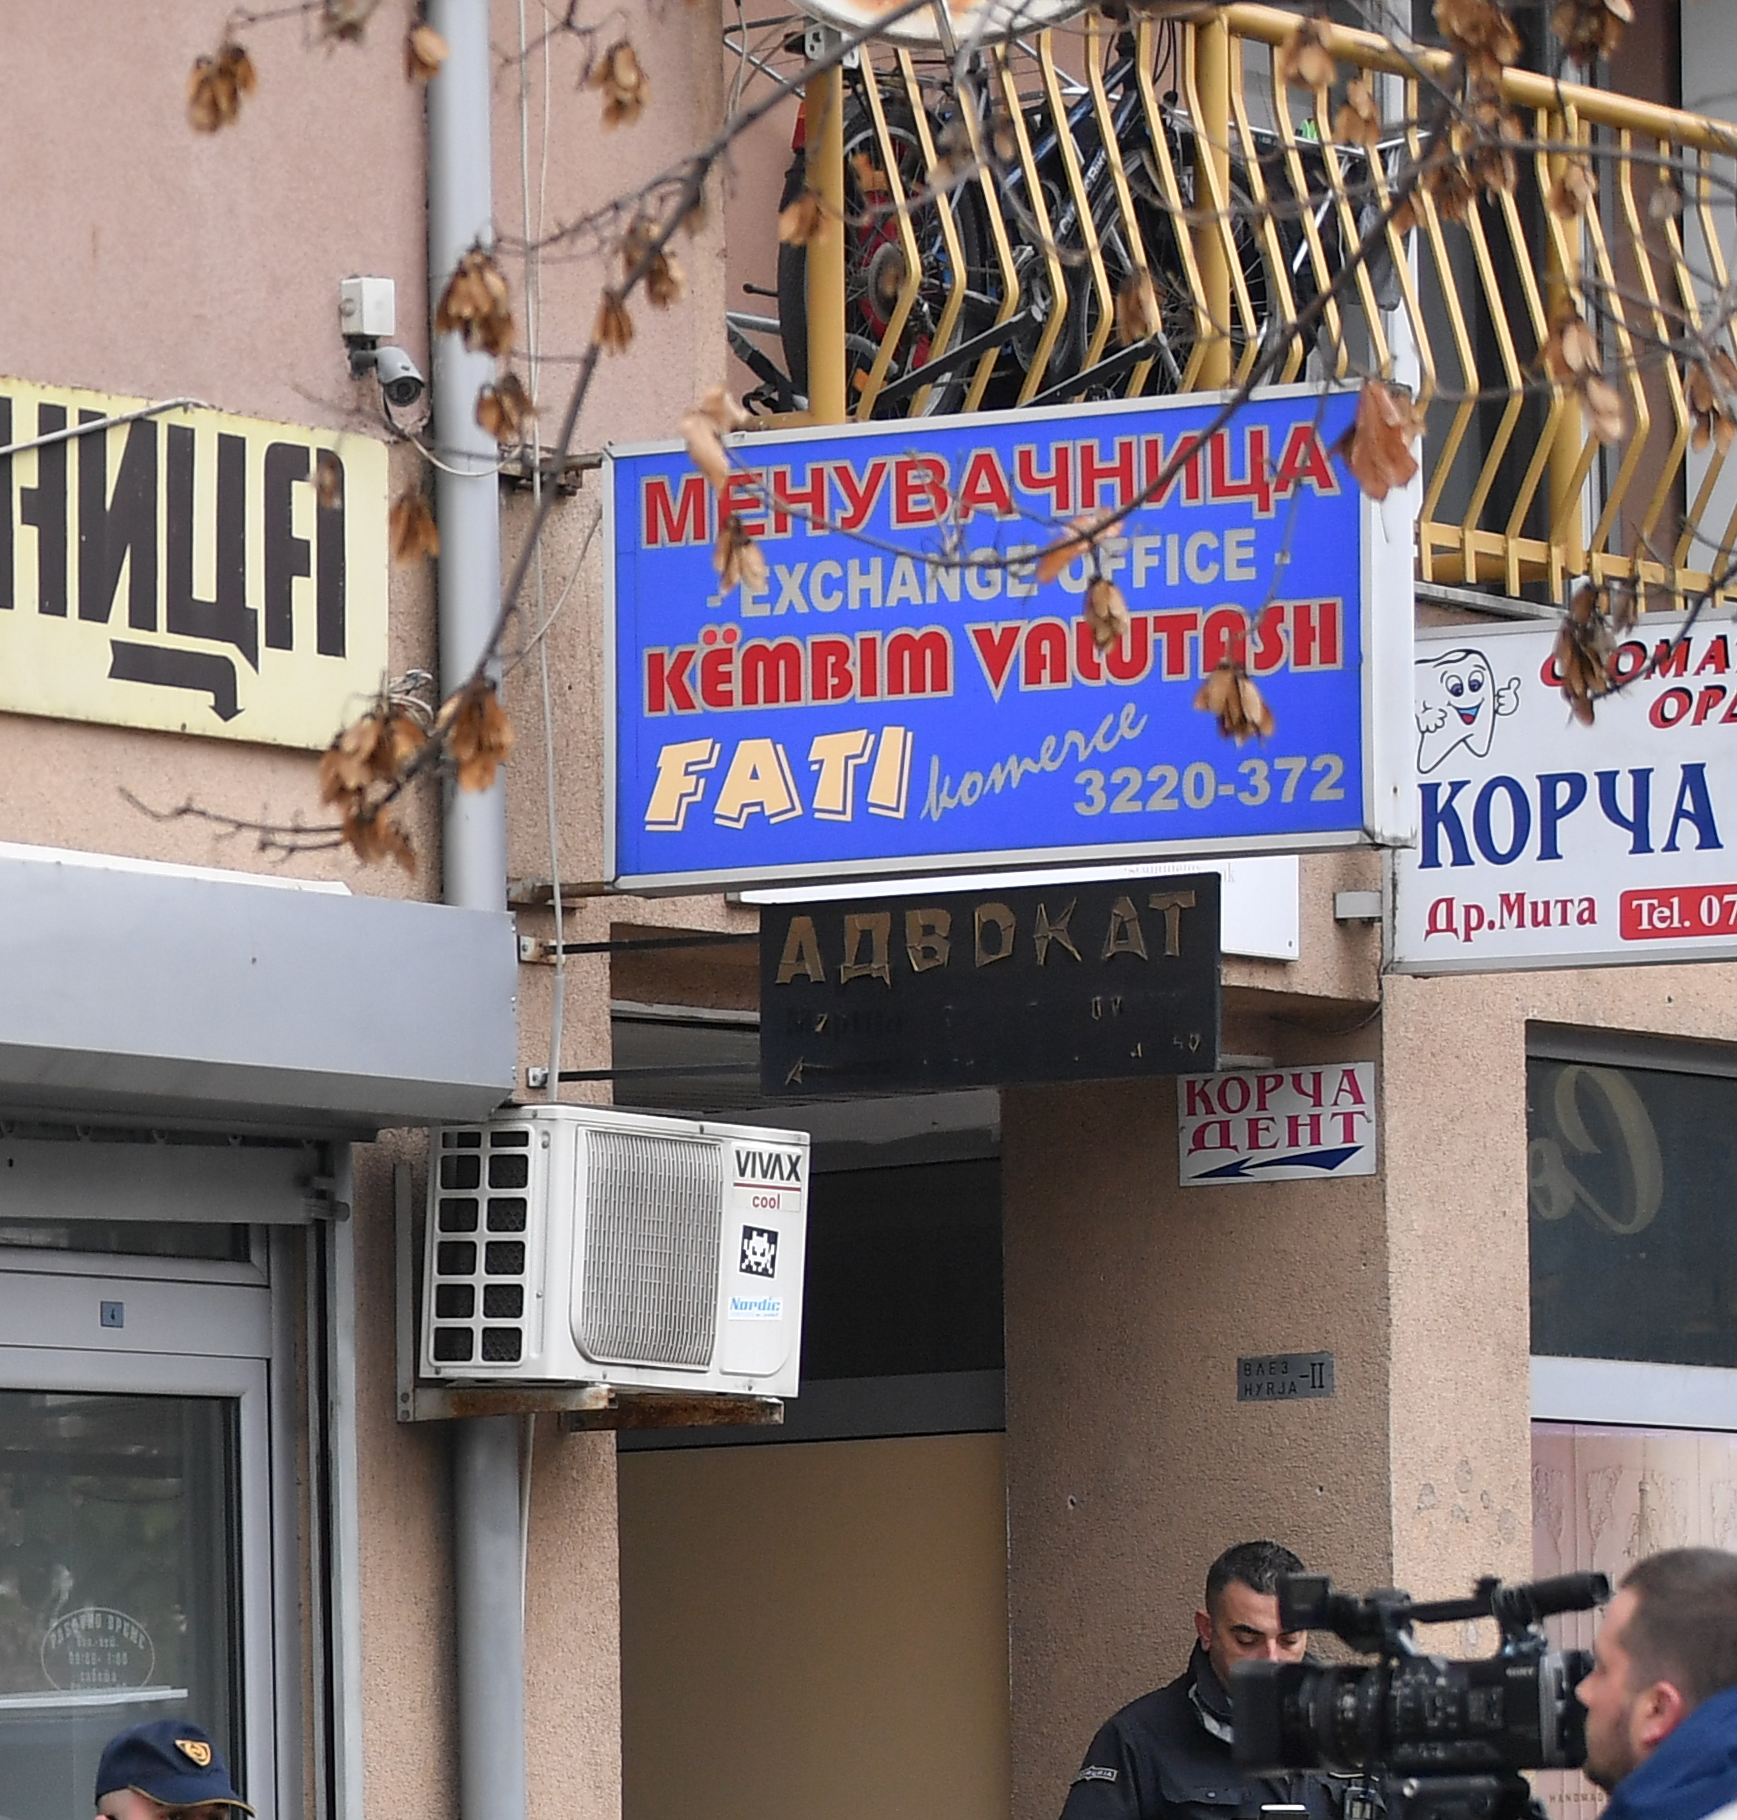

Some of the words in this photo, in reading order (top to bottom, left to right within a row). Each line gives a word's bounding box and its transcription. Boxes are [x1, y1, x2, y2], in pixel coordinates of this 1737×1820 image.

[641, 424, 1341, 550] МЕНУВАЧНИЦА
[739, 543, 1037, 619] EXCHANGE
[1058, 527, 1256, 595] OFFICE
[966, 597, 1343, 702] VALUTASH
[1540, 634, 1731, 687] СОМА
[645, 726, 913, 832] FATI
[922, 702, 1147, 821] komerce
[1074, 754, 1345, 816] 3220-372
[1417, 762, 1723, 871] КОРЧА
[775, 890, 1196, 989] АДВОКАТ
[1631, 899, 1690, 931] Tel.
[1185, 1068, 1367, 1117] КОРЧА
[1187, 1110, 1373, 1157] ДЕНТ
[735, 1149, 802, 1182] VIVAX
[752, 1193, 781, 1209] cool
[730, 1296, 781, 1311] Nordic
[1244, 1381, 1298, 1397] HYRJA
[1549, 1792, 1605, 1804] HANDMAD
